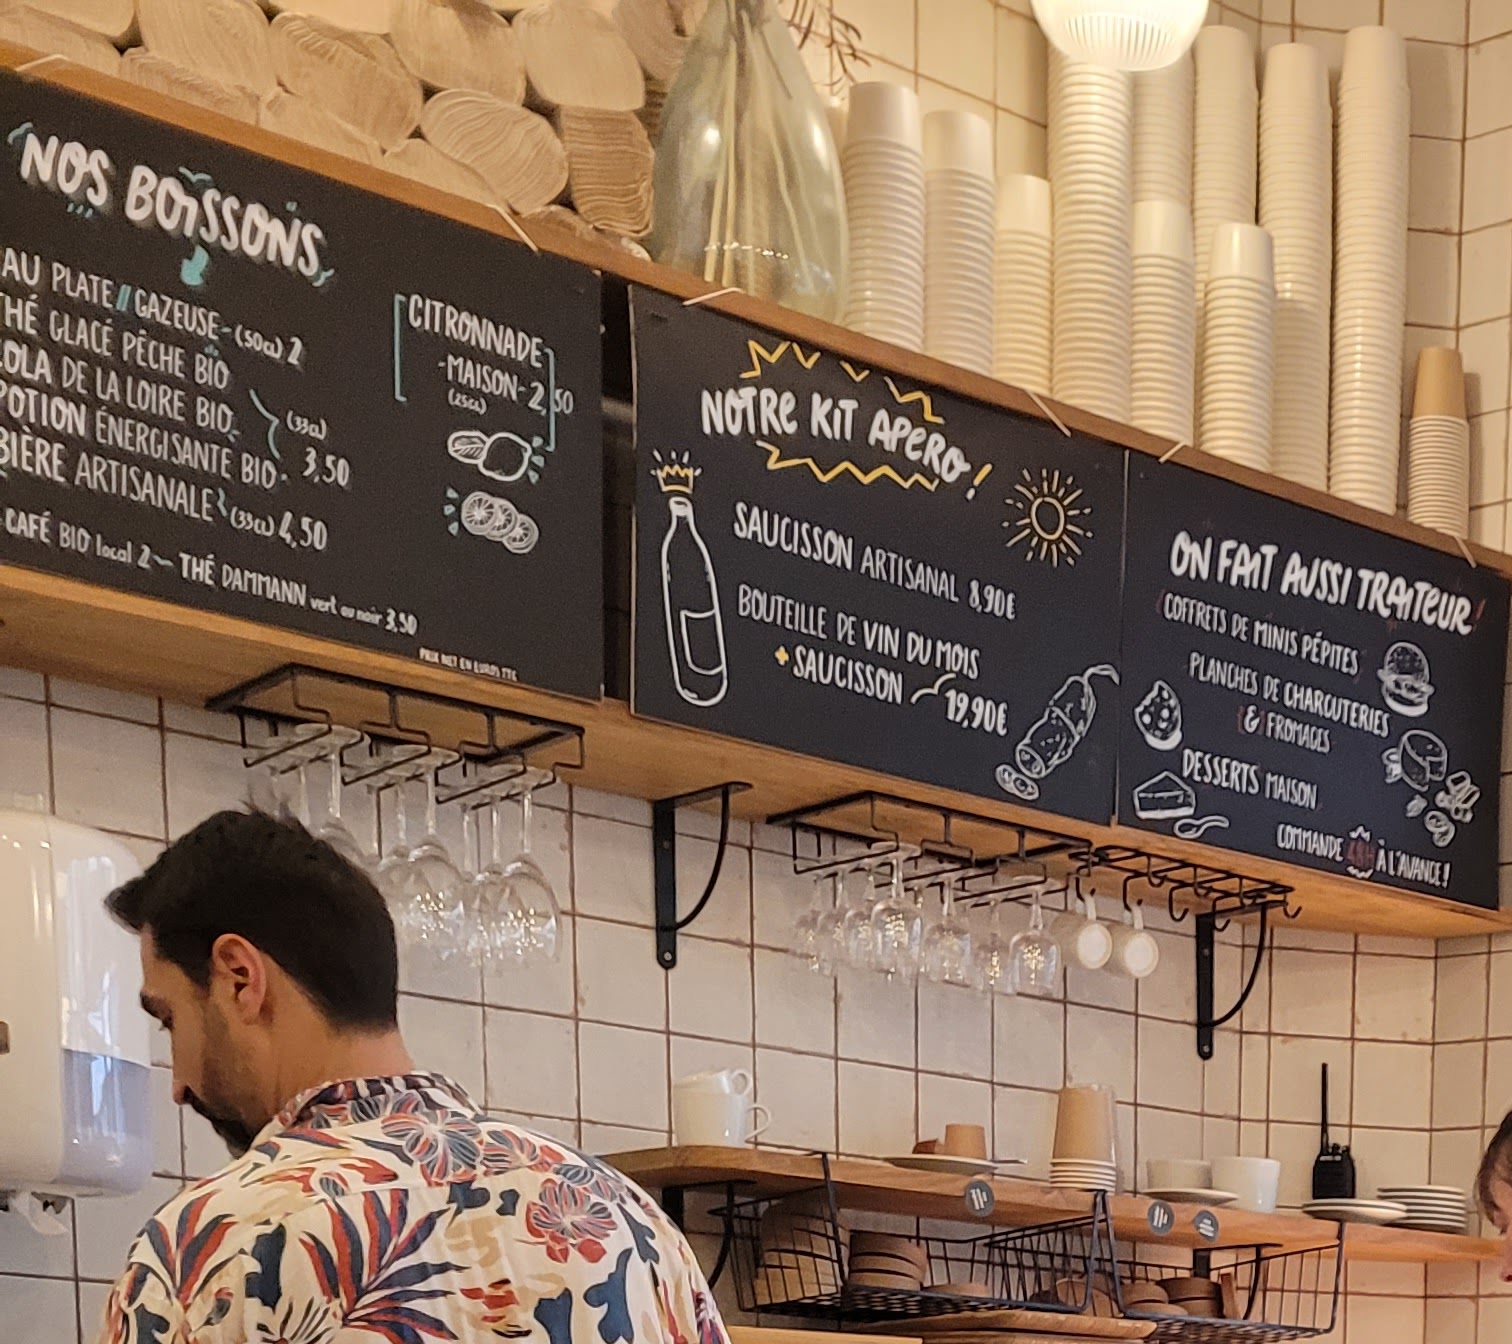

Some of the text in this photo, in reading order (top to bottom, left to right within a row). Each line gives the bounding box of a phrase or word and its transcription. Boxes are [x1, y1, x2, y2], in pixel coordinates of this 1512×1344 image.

[21, 133, 323, 276] NOS BOISSONS
[50, 310, 114, 357] GLACÉ
[122, 329, 185, 379] PÊCHE
[195, 353, 230, 389] BIO
[52, 262, 113, 308] PLATE
[287, 337, 303, 365] 2
[408, 294, 543, 369] CITRONNADE
[0, 340, 233, 434] OLA DE LA LOIRE BIO
[701, 386, 799, 436] NOTRE
[810, 391, 858, 441] KIT
[95, 406, 232, 480] ÉNERGISANTE
[302, 447, 350, 488] 3,50
[74, 452, 214, 523] ARTISANALE
[278, 510, 328, 551] 4,50
[5, 507, 51, 543] CAFÉ
[59, 522, 91, 553] BIO
[96, 534, 132, 564] local
[179, 552, 216, 586] THÉ
[222, 563, 307, 606] DAMMANN
[310, 595, 337, 615] vert
[340, 605, 355, 619] ou
[356, 607, 383, 626] noir
[733, 501, 1016, 620] SAUCISSON ARTISANAL 8,90€
[1170, 530, 1213, 581] ON
[1216, 539, 1278, 592] FAIT
[1280, 551, 1352, 606] AUSSI
[738, 584, 981, 680] BOUTEILLE DE VIN DU MOIS
[1163, 592, 1360, 676] COFFRETS DE MINIS PÉPITES
[793, 644, 903, 705] SAUCISSON
[945, 688, 1009, 737] 19,90€
[1188, 651, 1391, 739] PLANCHES DE CHARCUTERIES
[1265, 711, 1331, 755] FROMAGES
[1182, 748, 1318, 810] DESSERTS MAISON
[1276, 823, 1345, 862] COMMANDE
